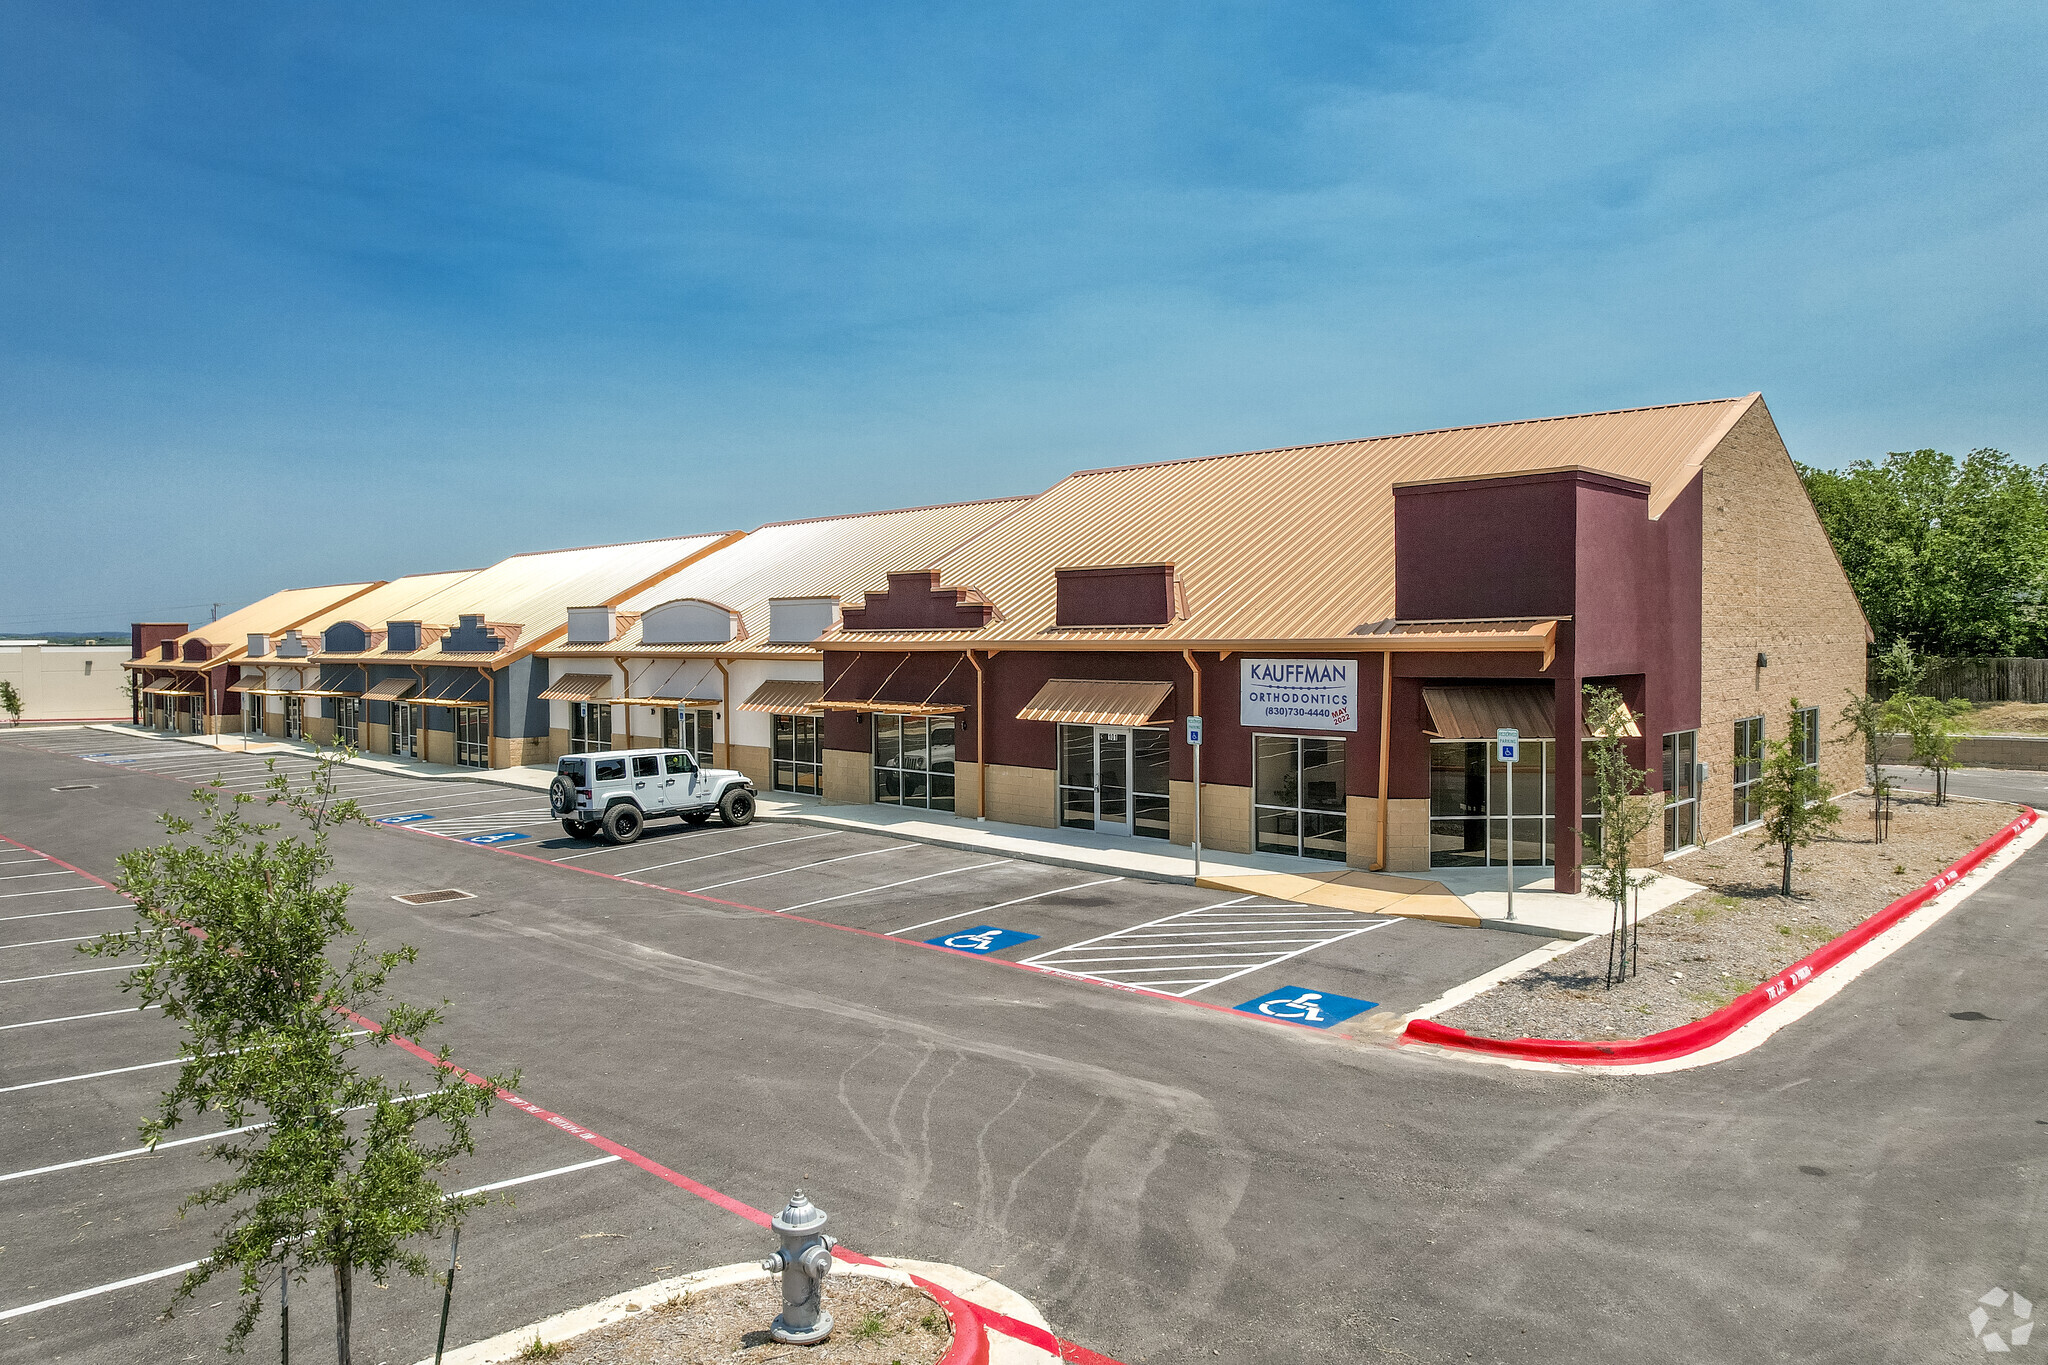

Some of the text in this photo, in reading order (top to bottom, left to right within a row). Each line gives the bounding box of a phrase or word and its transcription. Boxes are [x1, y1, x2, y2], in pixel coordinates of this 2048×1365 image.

[1251, 664, 1345, 683] KAUFFMAN
[1249, 692, 1347, 705] ORTHODONTICS
[1265, 707, 1330, 717] (830)730-4440
[1331, 707, 1348, 718] MAY
[1334, 714, 1350, 725] 2022
[546, 1117, 585, 1134] PARKING
